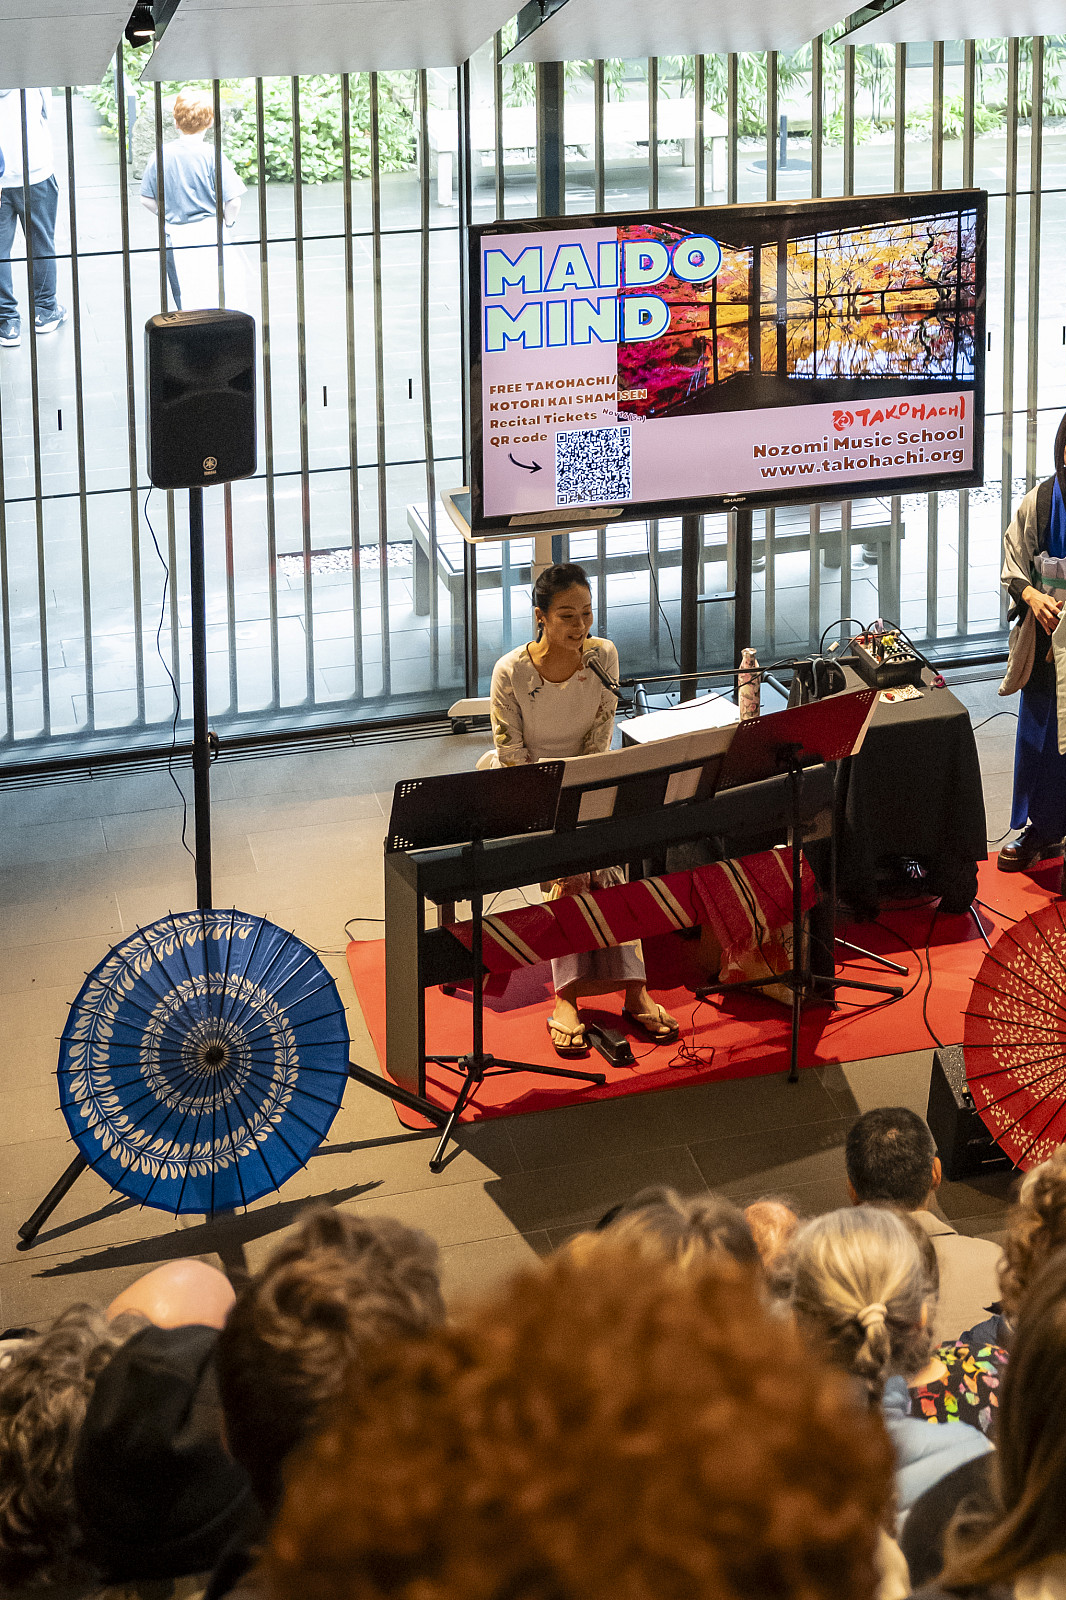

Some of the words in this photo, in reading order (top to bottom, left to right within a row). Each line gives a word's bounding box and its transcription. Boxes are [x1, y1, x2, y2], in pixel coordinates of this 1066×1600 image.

[484, 234, 722, 297] MAIDO
[484, 294, 672, 352] MIND
[489, 383, 522, 394] FREE
[526, 375, 617, 391] TAKOHACHI/
[490, 398, 544, 411] KOTORI
[548, 396, 573, 406] KAI
[576, 389, 647, 404] SHAMISEN
[855, 395, 965, 427] TAKOHACHI
[490, 415, 540, 428] Recital
[544, 412, 597, 424] Tickets
[490, 436, 510, 447] QR
[513, 432, 548, 443] code
[753, 436, 828, 458] Nozomi
[833, 431, 893, 451] Music
[897, 426, 964, 445] School
[760, 448, 964, 478] www.takohachi.org
